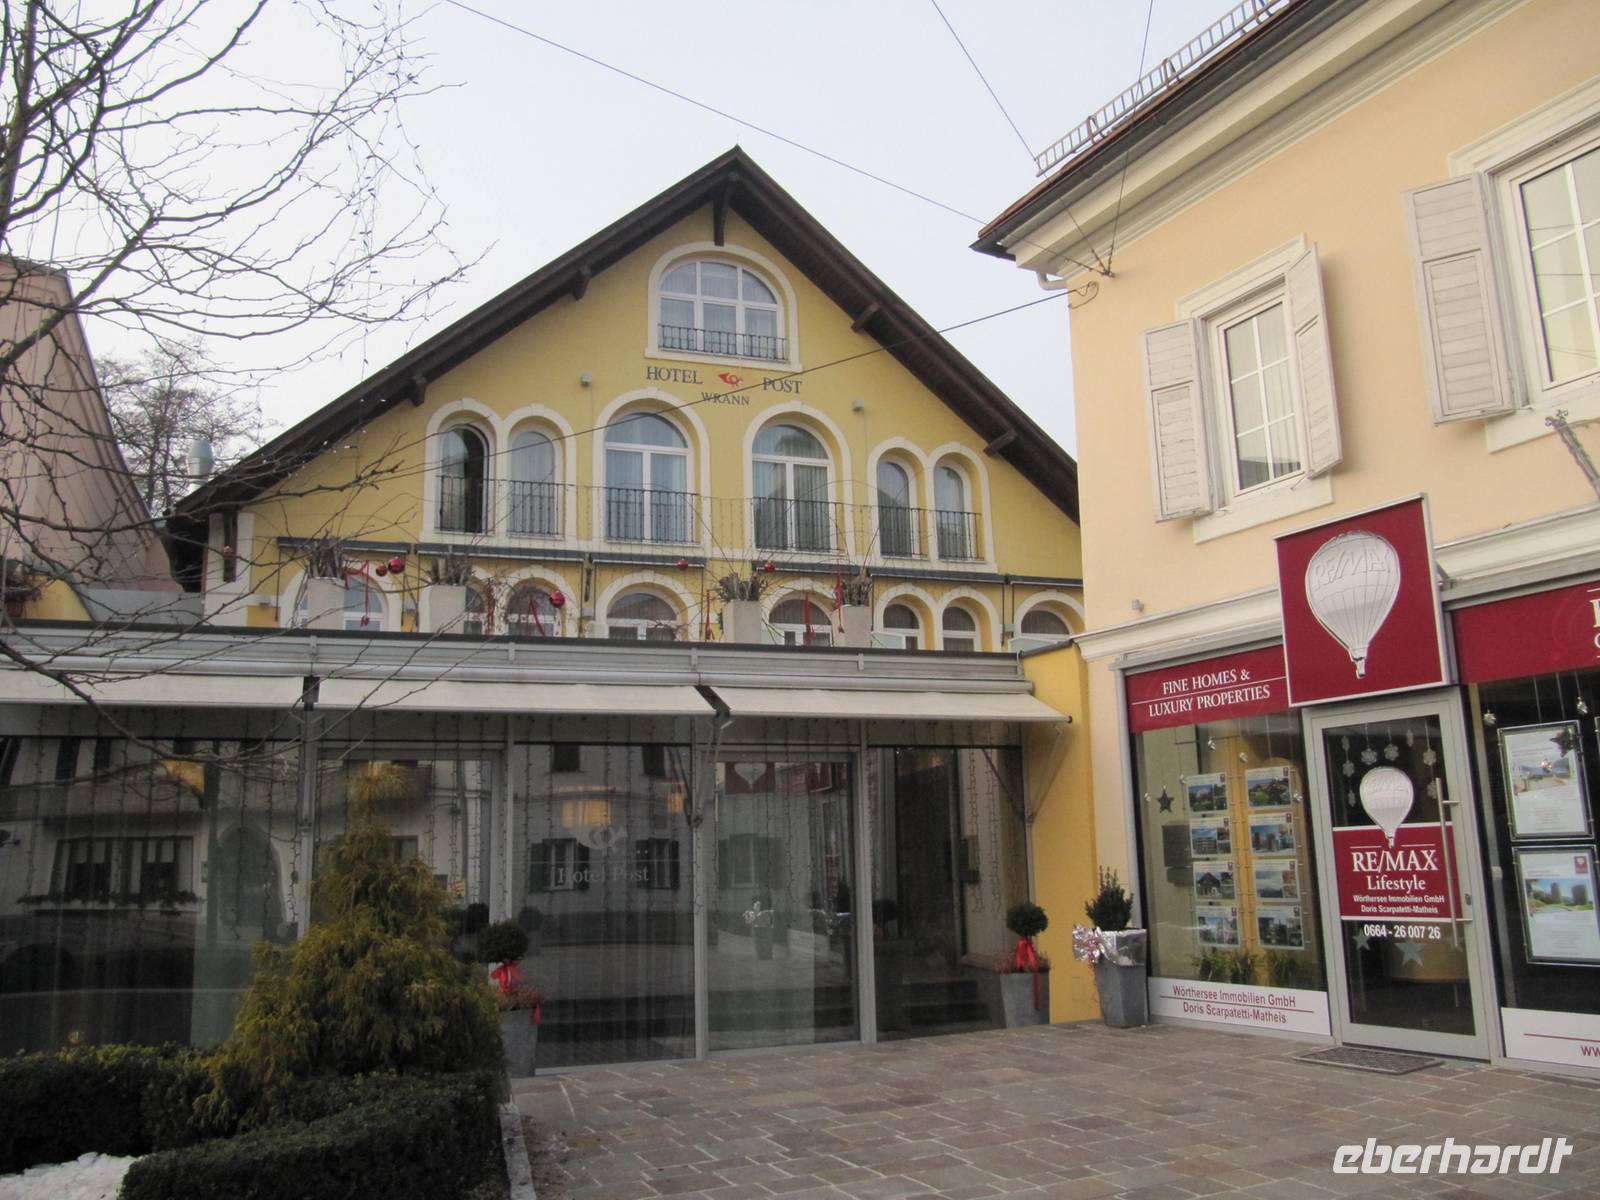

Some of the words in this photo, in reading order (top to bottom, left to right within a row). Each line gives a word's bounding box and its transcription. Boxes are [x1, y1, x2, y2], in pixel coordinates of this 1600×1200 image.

[646, 366, 703, 385] HOTEL
[762, 377, 803, 394] POST
[701, 392, 750, 406] WRANN
[1162, 678, 1189, 695] FINE
[1192, 668, 1237, 690] HOMES
[1240, 669, 1250, 681] &
[1148, 697, 1194, 717] LUXURY
[1197, 684, 1271, 710] PROPERTIES
[1351, 850, 1438, 873] RE/MAX
[1366, 874, 1426, 894] Lifestyle
[1361, 904, 1377, 913] Doris
[1388, 894, 1423, 903] Immobilien
[1423, 894, 1445, 904] GmbH
[1364, 924, 1387, 937] 0664
[1394, 925, 1407, 938] 26
[1407, 925, 1426, 938] 007
[1428, 926, 1441, 939] 26
[1172, 985, 1217, 1000] Wörthersee
[1219, 990, 1266, 1004] Immobilien
[1267, 994, 1296, 1008] GmbH
[1183, 1001, 1205, 1015] Doris
[1206, 1004, 1287, 1024] Scarpatetti-Matheis
